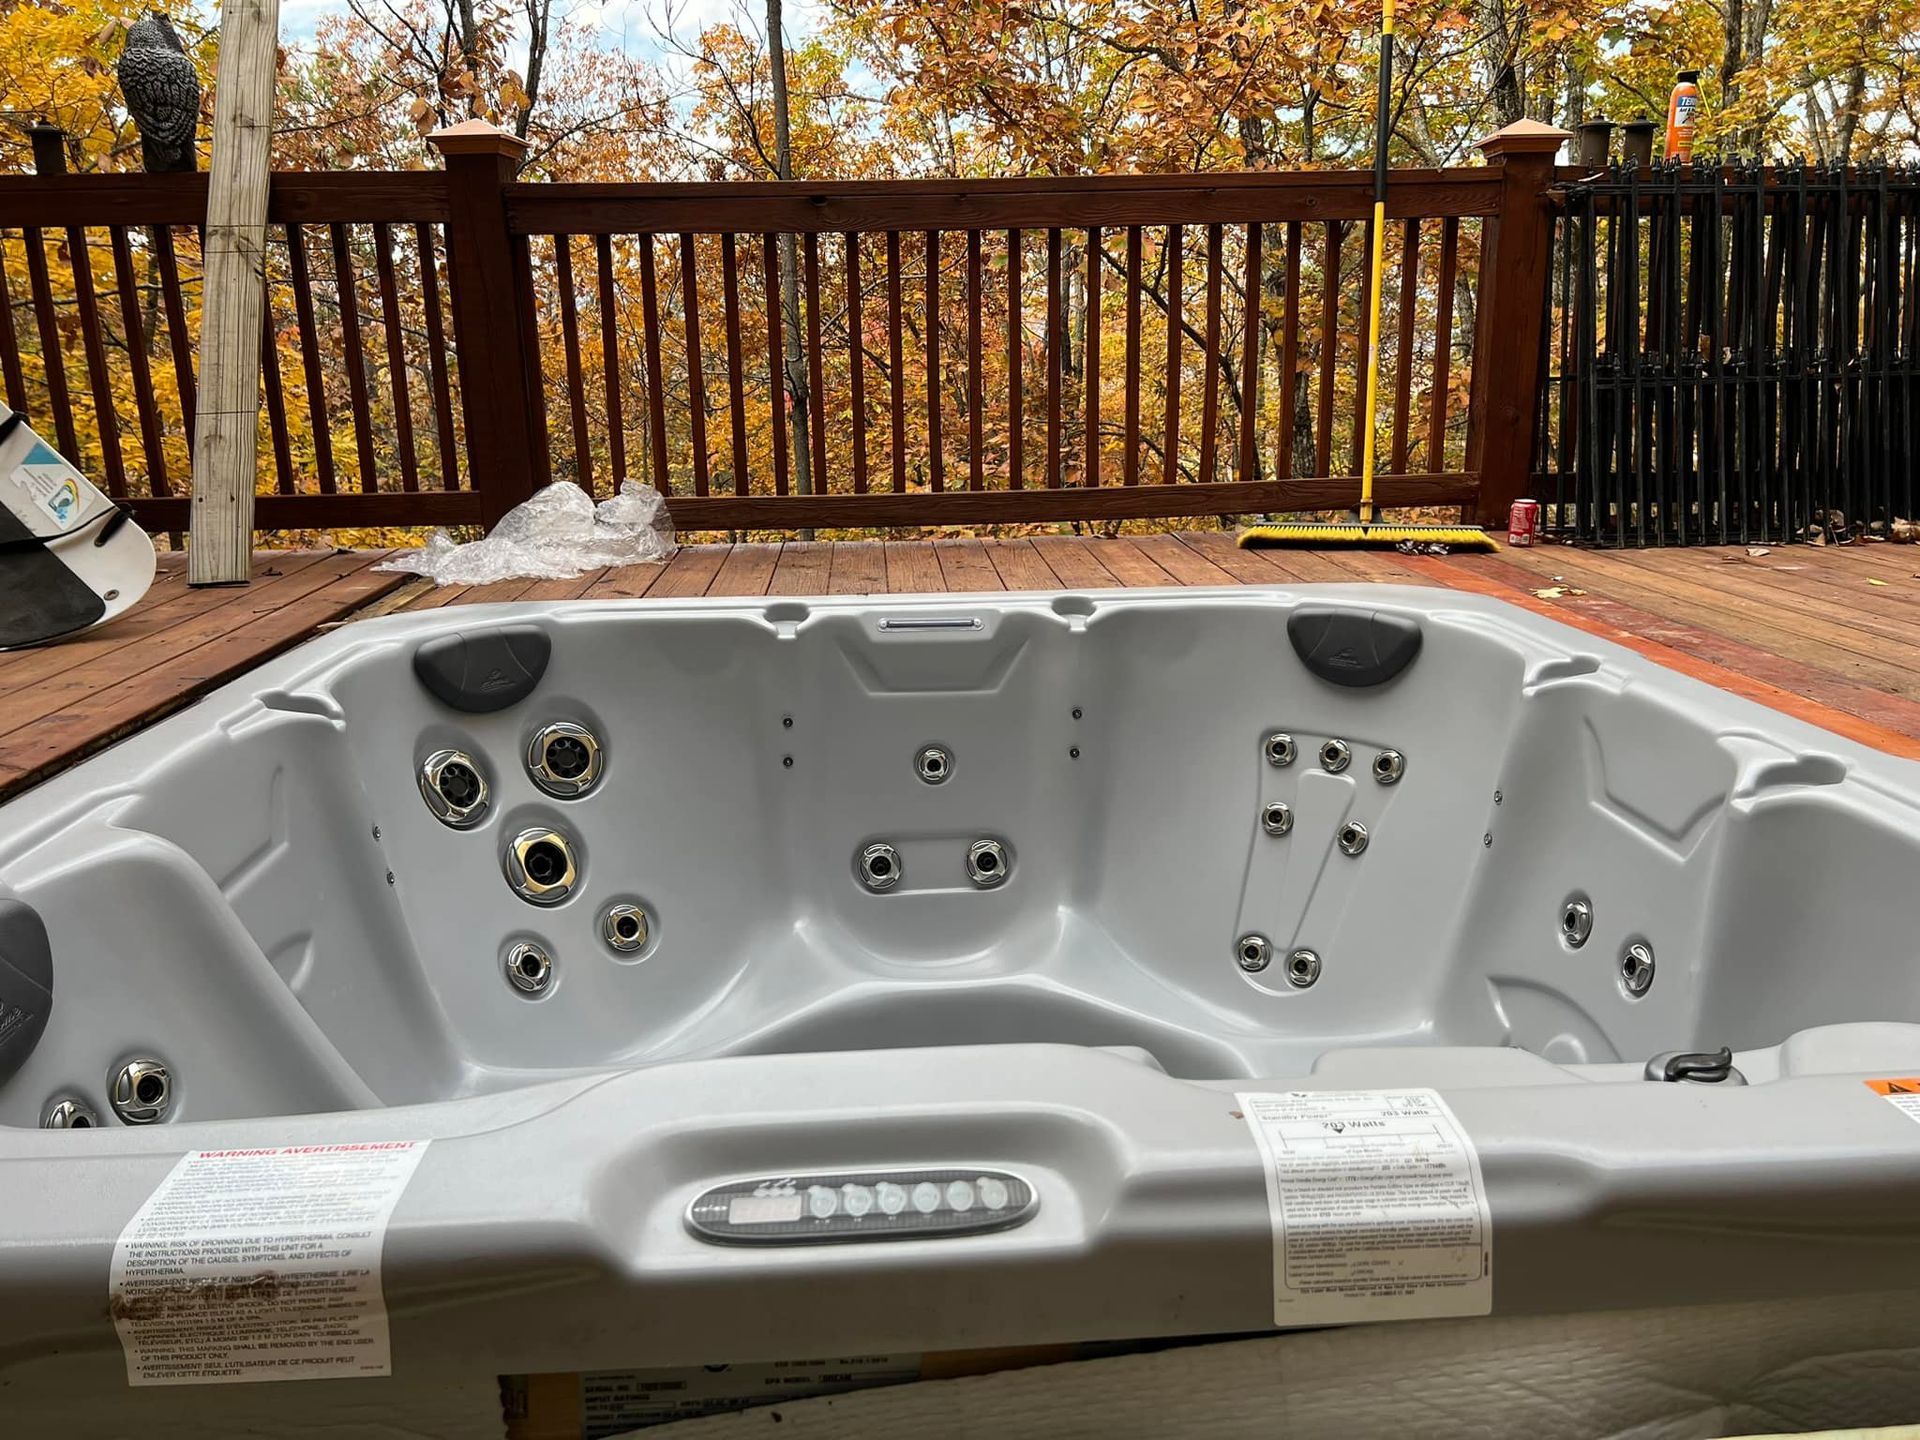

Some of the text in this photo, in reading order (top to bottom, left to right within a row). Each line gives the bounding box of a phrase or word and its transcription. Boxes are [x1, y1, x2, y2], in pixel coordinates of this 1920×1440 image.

[1348, 1120, 1387, 1128] Watts
[200, 1141, 416, 1159] WARNING AVERTISSEMENT
[201, 1238, 243, 1246] DROWNING
[144, 1248, 200, 1257] INSTRUCTIONS
[201, 1247, 239, 1255] PROVIDED
[126, 1259, 177, 1267] DESCRIPTION
[289, 1252, 305, 1260] AND
[306, 1250, 340, 1259] EFFECTS
[341, 1249, 352, 1257] OF
[125, 1288, 152, 1296] NOTICE
[166, 1311, 208, 1319] APPLIANCE
[196, 1344, 232, 1352] MARKING
[301, 1357, 334, 1365] PRODUIT
